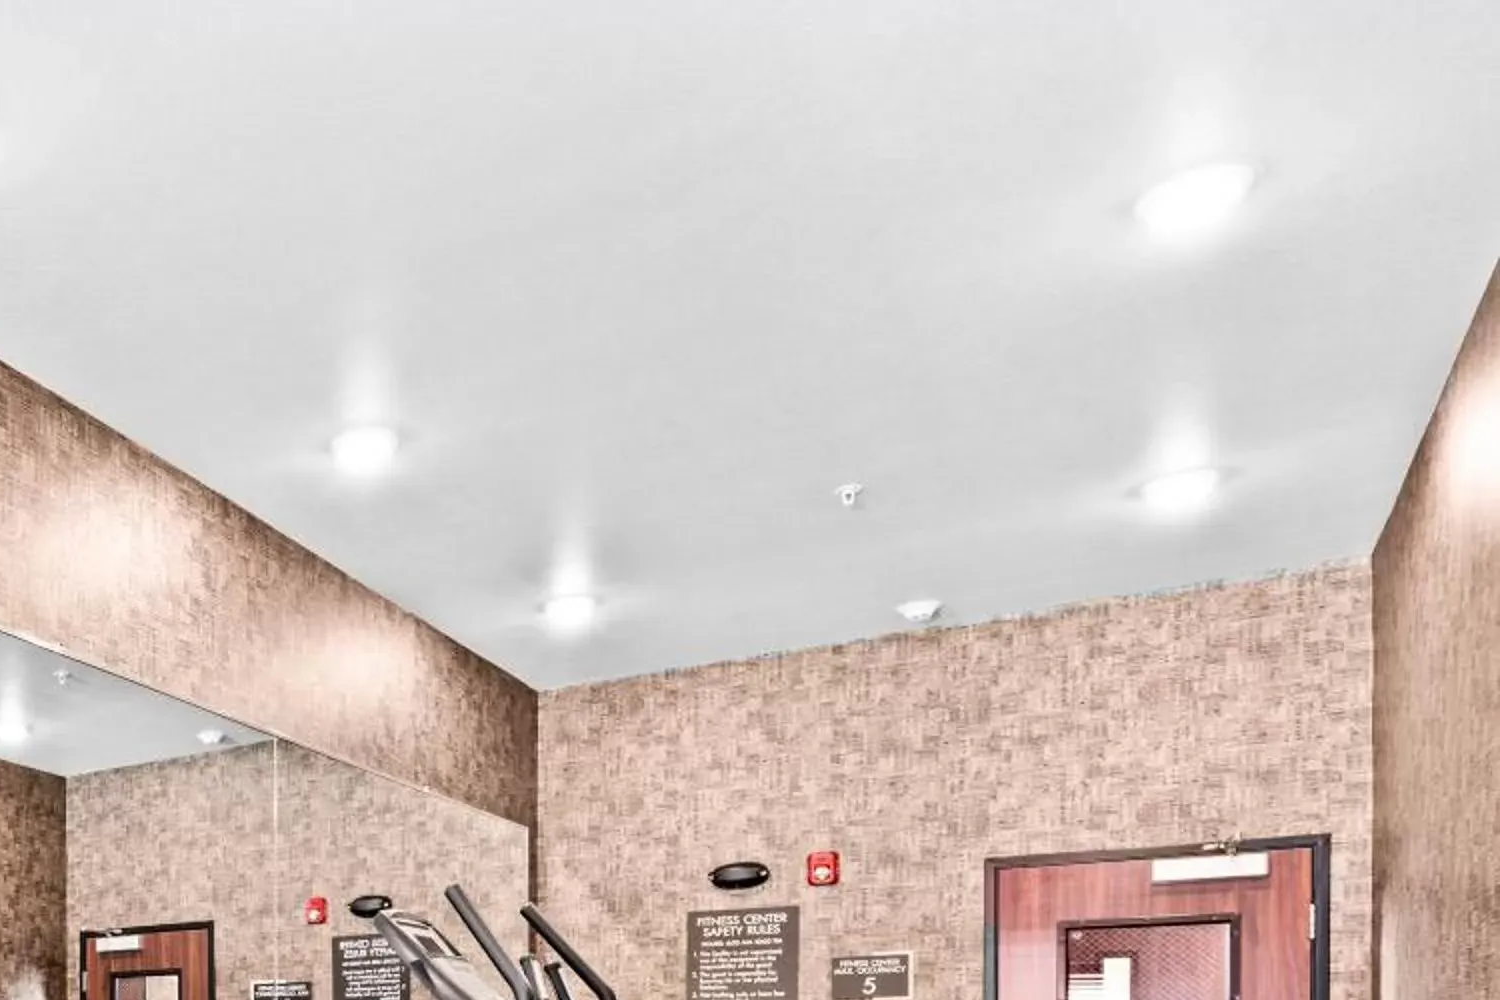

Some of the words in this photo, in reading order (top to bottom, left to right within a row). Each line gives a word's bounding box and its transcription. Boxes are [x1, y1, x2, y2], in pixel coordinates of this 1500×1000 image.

[696, 915, 741, 927] FITNESS
[743, 912, 788, 923] CENTER
[703, 925, 743, 937] SAFETY
[747, 923, 781, 935] RULES
[861, 976, 877, 995] 5
